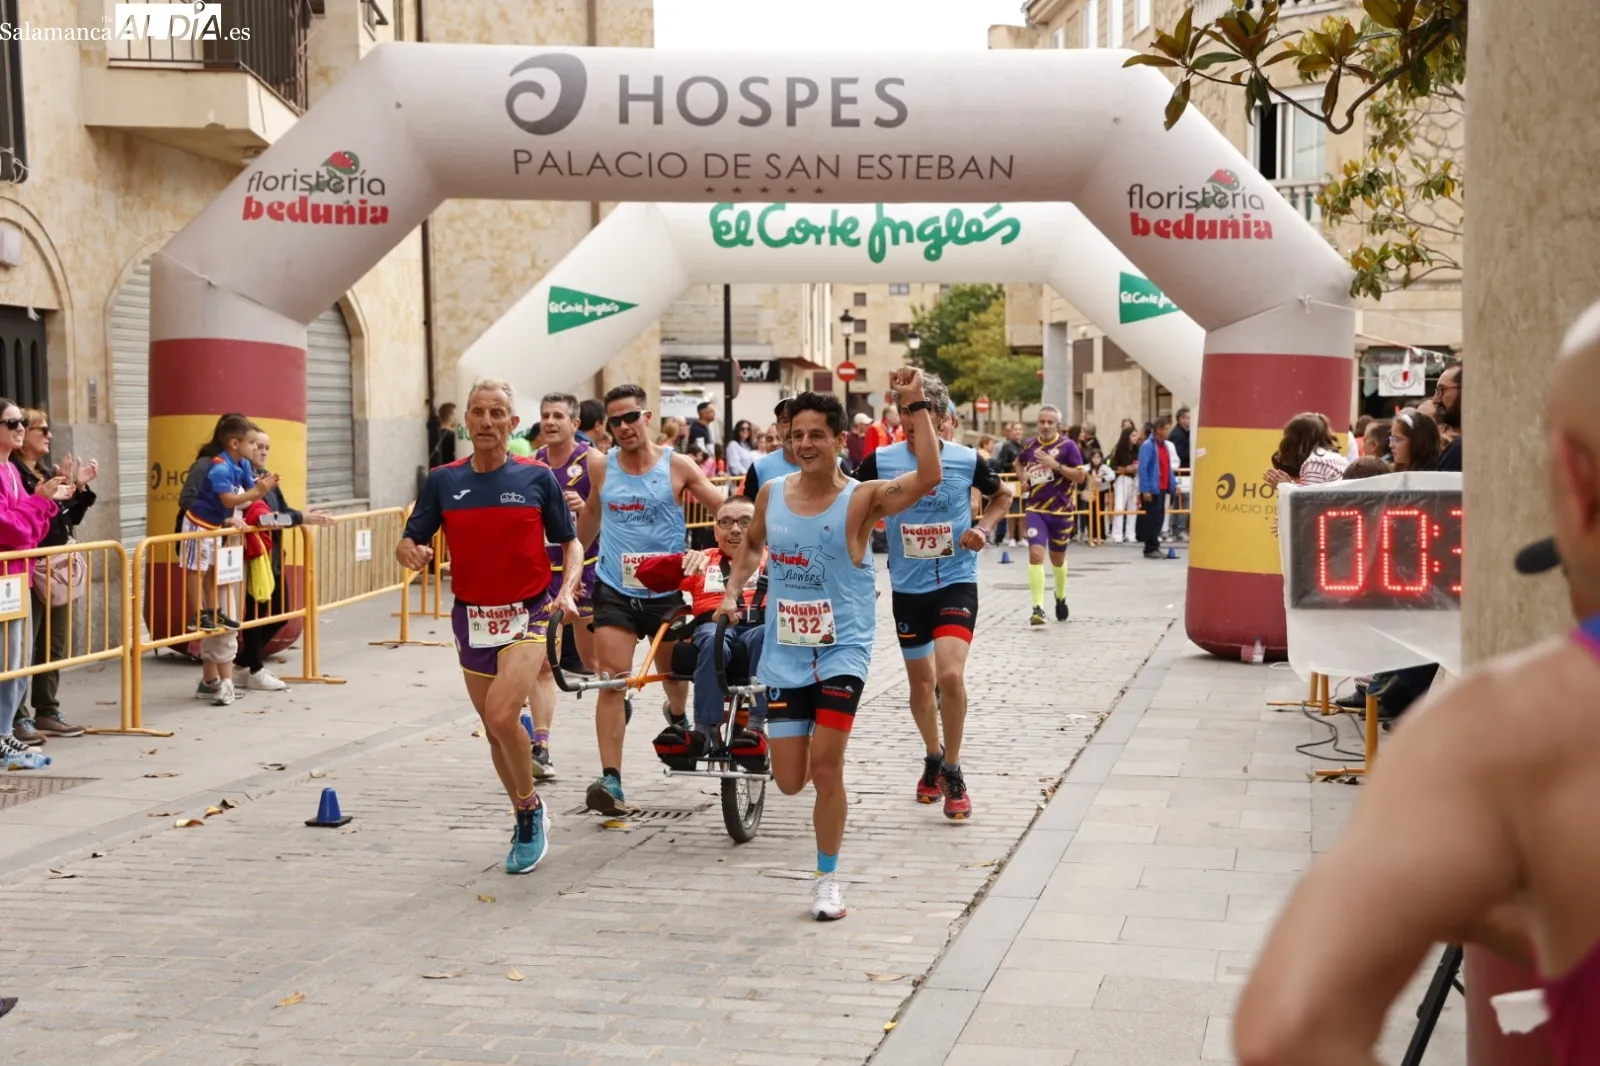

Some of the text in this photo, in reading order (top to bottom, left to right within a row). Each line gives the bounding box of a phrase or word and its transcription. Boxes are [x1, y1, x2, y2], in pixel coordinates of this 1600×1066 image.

[618, 74, 908, 128] HOSPES
[513, 149, 1015, 180] PALACIO DE SAN ESTEBAN
[247, 168, 386, 196] floristería
[1127, 183, 1265, 211] floristería
[242, 195, 389, 225] bedunia
[709, 202, 1021, 264] El Corte Inglés
[1129, 212, 1274, 240] bedunia
[1243, 483, 1280, 499] HO
[1215, 502, 1262, 514] PALACIO
[902, 525, 951, 536] bedunia
[916, 536, 937, 550] 73
[778, 602, 832, 616] bedunia
[488, 619, 510, 636] 82
[788, 616, 822, 635] 132
